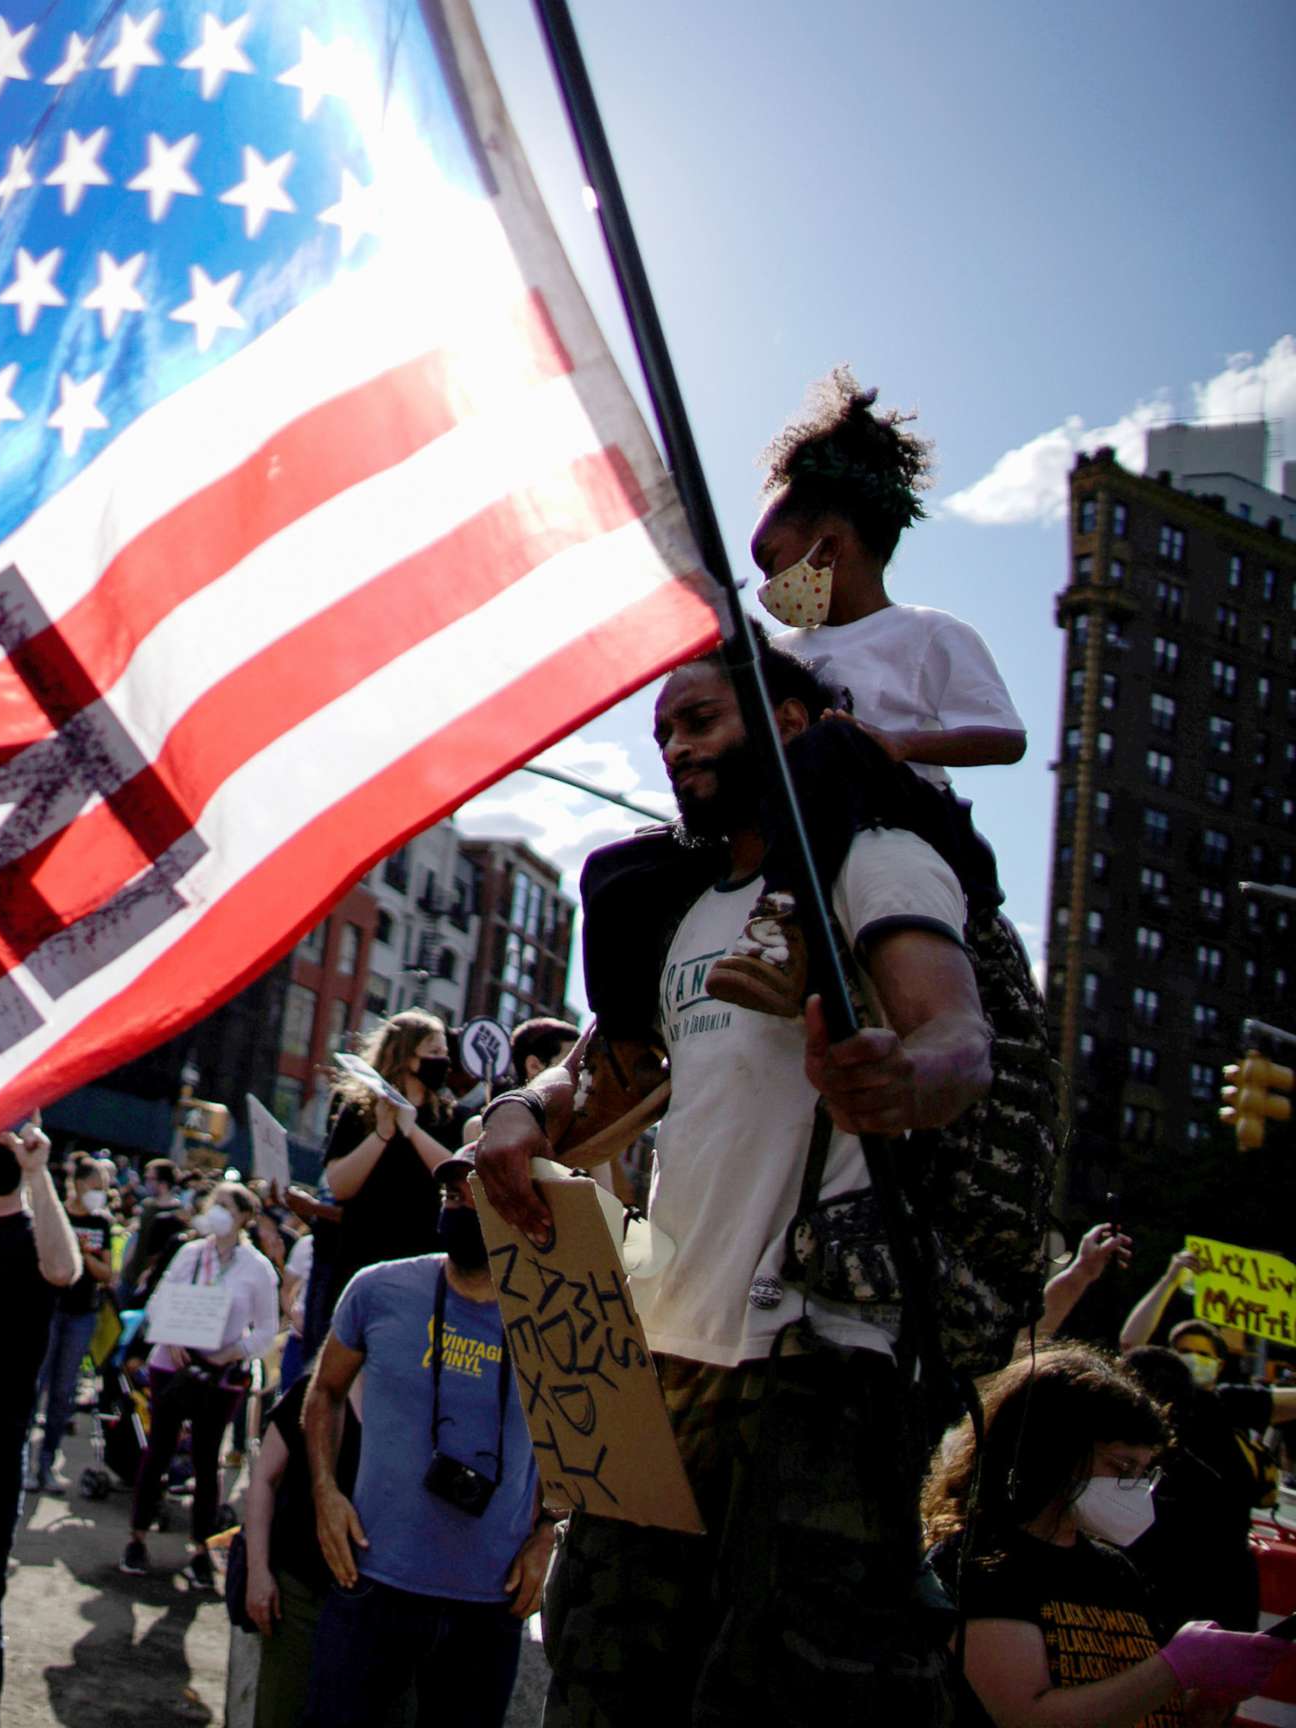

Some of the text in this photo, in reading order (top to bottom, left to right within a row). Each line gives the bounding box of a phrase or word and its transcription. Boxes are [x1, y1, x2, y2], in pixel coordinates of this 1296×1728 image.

[524, 1225, 621, 1505] DADDY
[564, 1279, 620, 1393] MY
[587, 1269, 649, 1370] IS
[1202, 1286, 1296, 1340] MATTE
[489, 1243, 586, 1512] NEXT?
